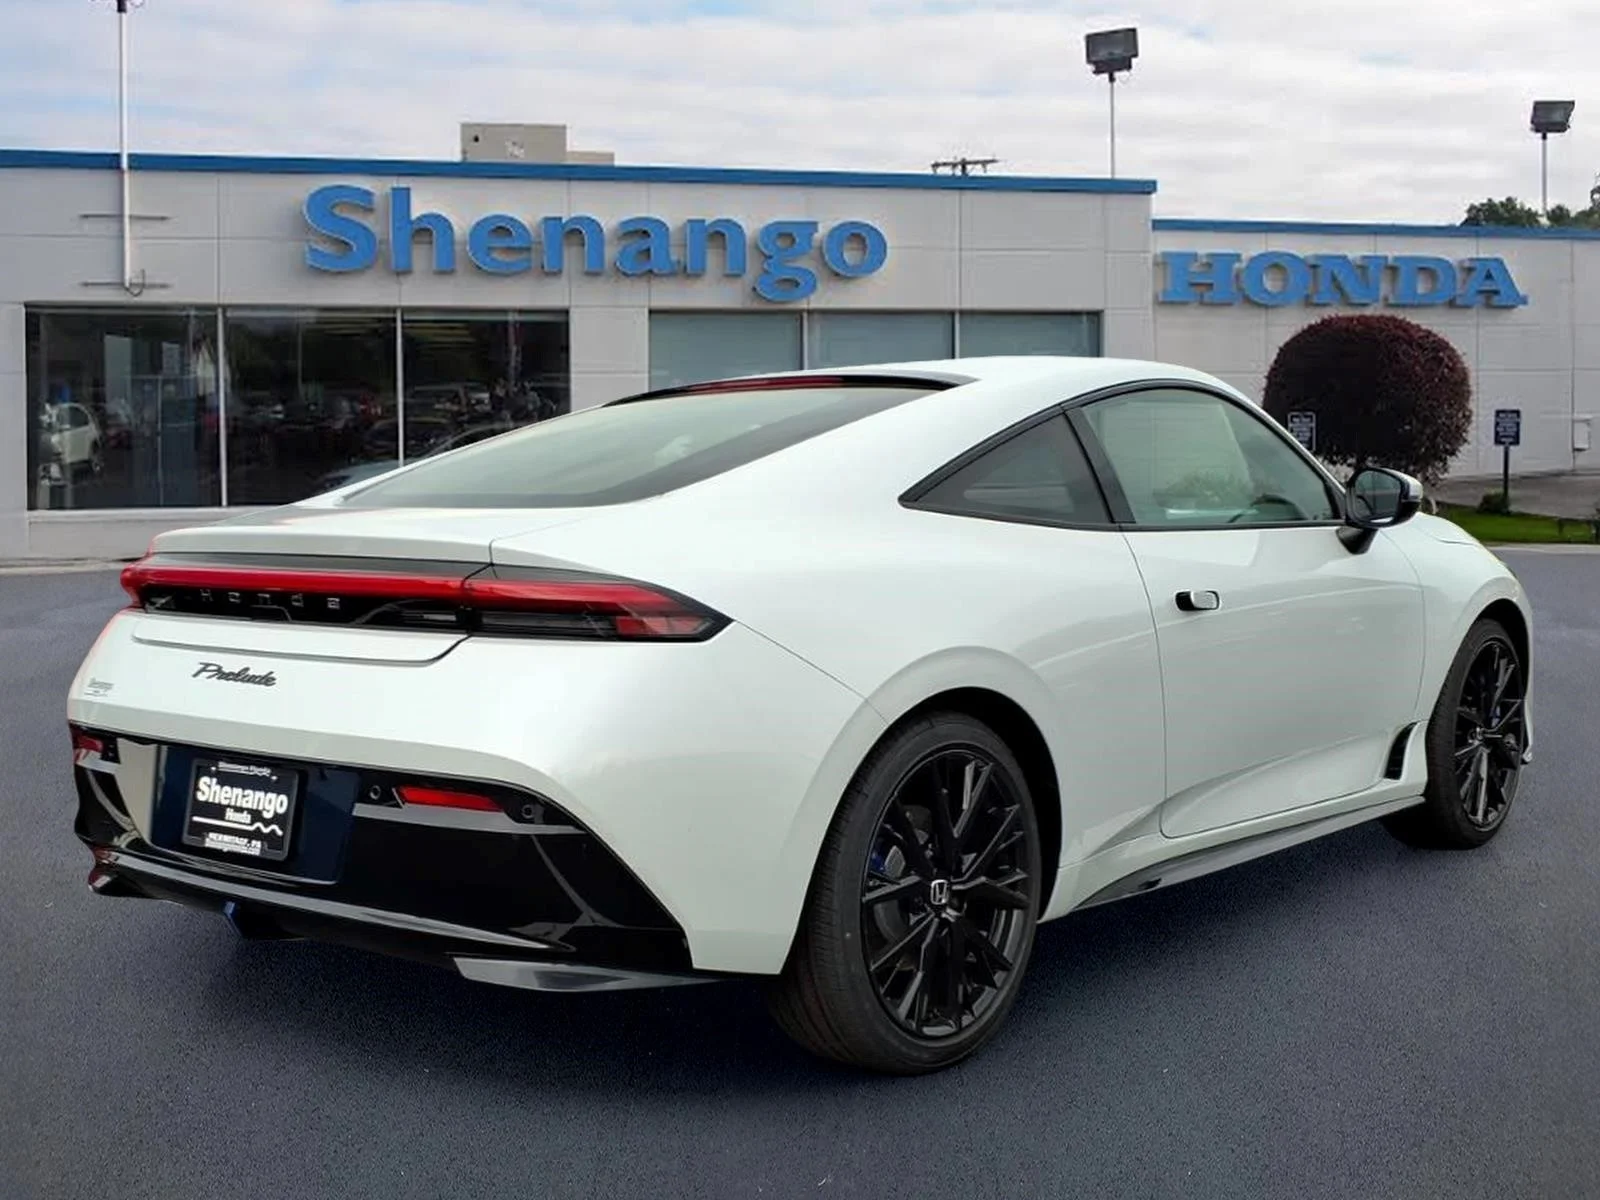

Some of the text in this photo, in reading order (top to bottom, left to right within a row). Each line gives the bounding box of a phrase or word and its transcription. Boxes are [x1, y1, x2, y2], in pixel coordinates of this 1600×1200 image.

[303, 184, 888, 302] Shenango
[1157, 250, 1528, 309] HONDA
[191, 662, 277, 687] Prelude
[196, 775, 289, 820] Shenango
[224, 807, 252, 824] Honda
